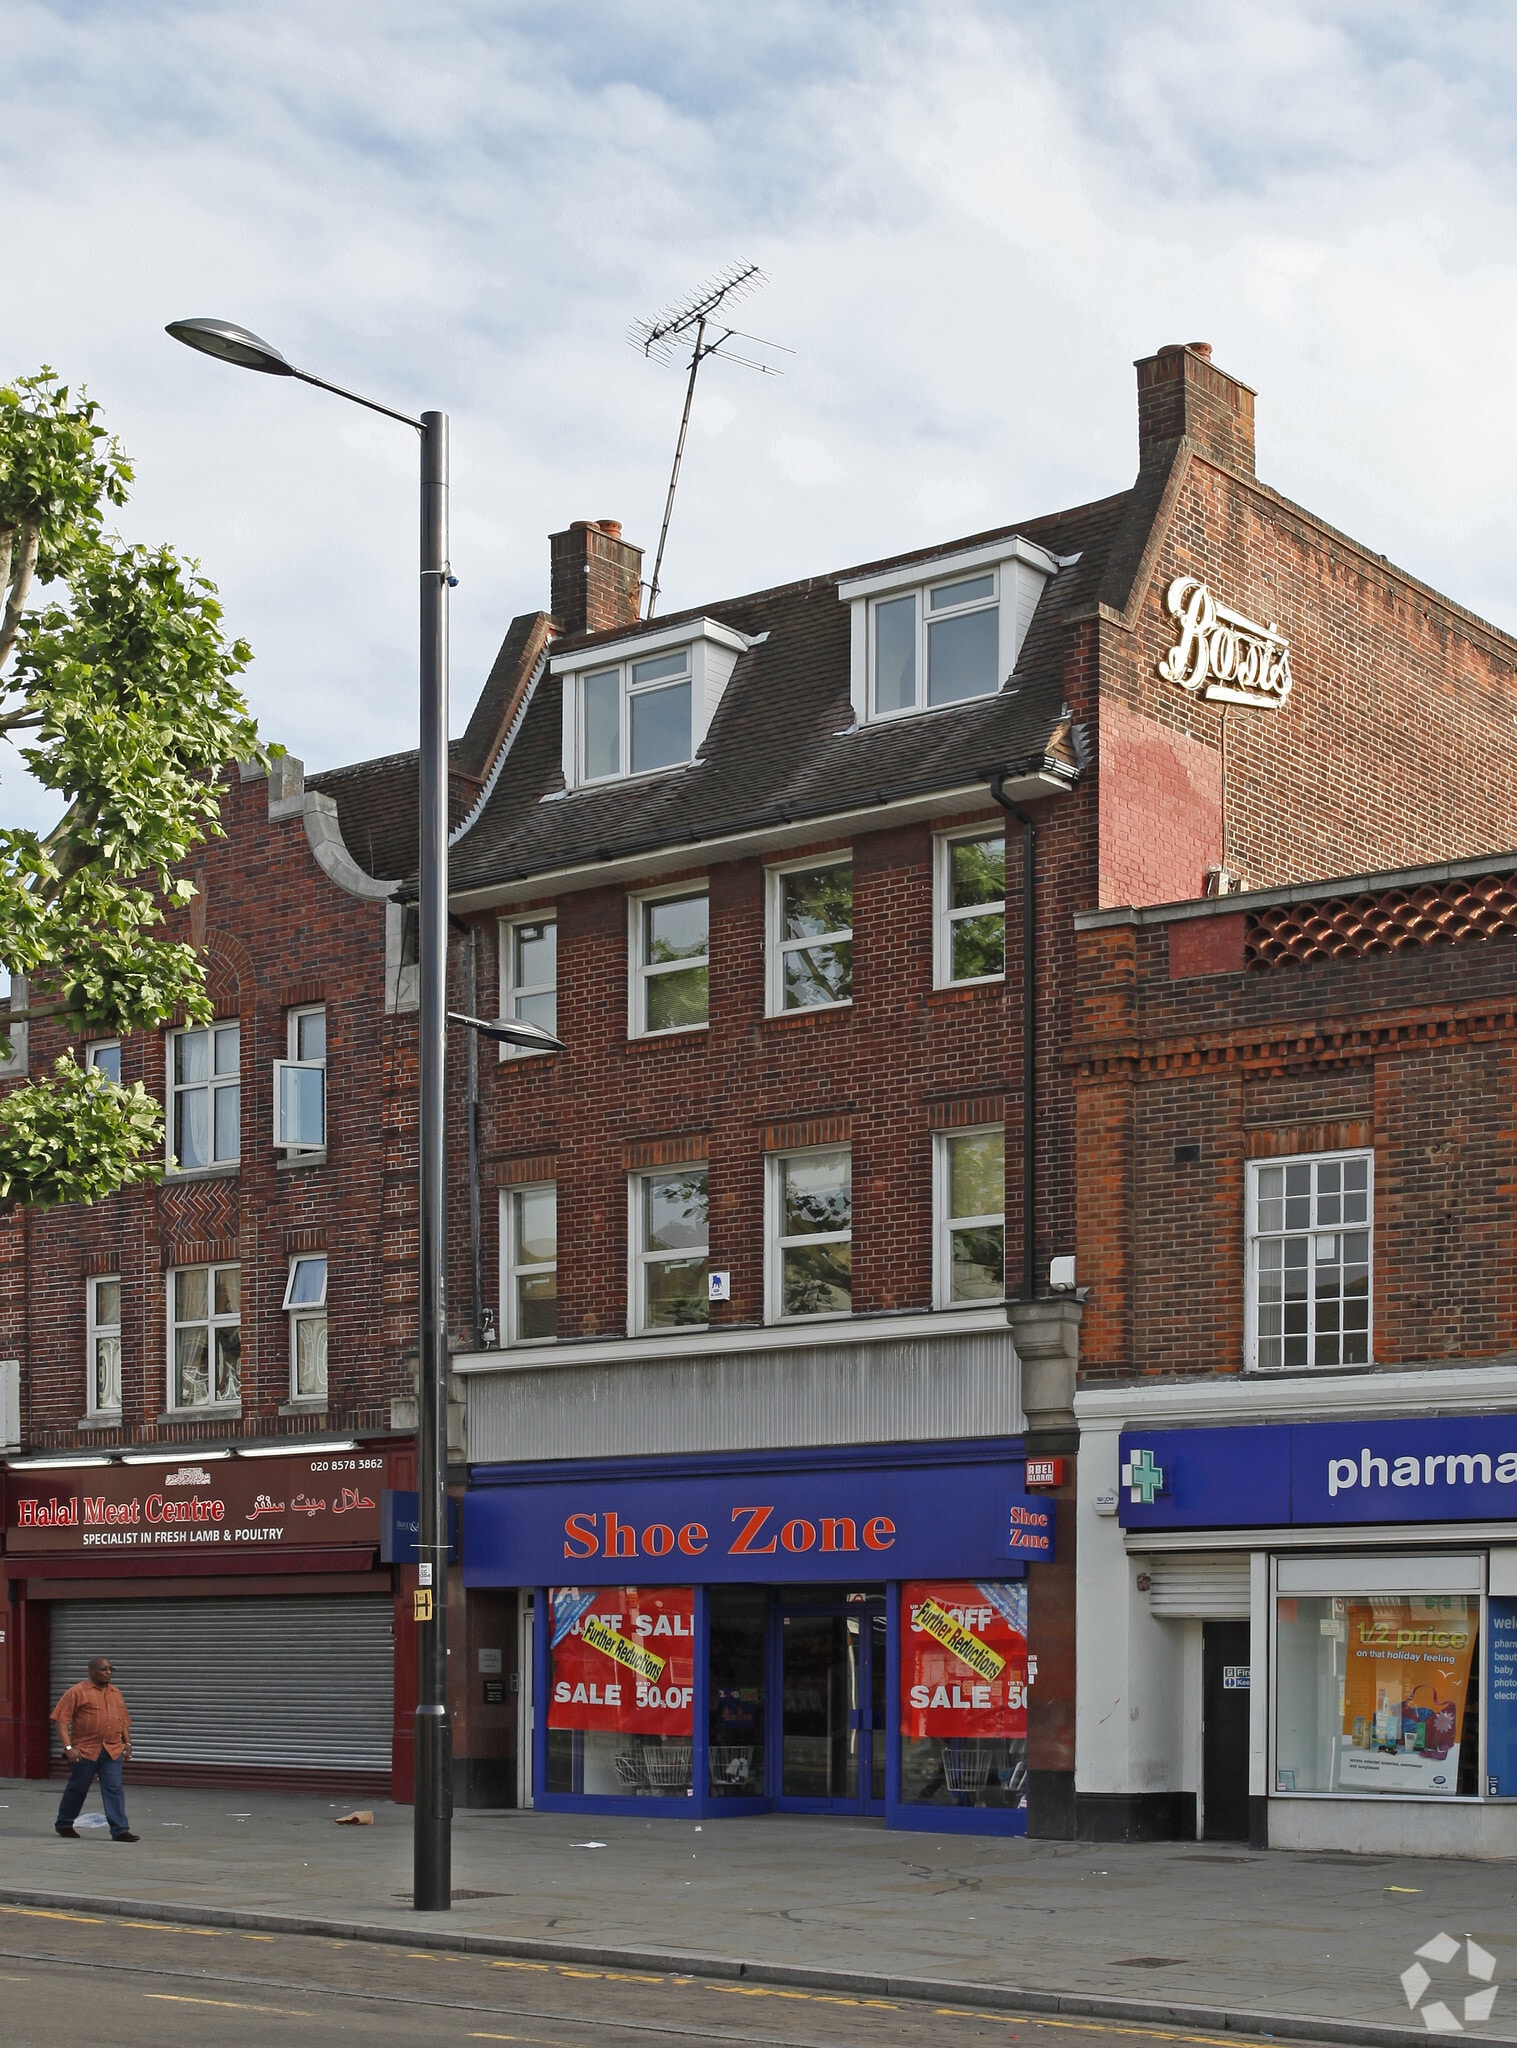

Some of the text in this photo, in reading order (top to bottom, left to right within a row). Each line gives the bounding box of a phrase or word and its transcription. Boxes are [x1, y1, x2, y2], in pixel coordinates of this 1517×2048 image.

[1158, 576, 1293, 709] Boots
[310, 1458, 383, 1472] 020 8578 3862
[1028, 1464, 1053, 1475] ABEL
[1328, 1448, 1517, 1497] pharma
[1028, 1474, 1053, 1482] ALARM
[18, 1494, 225, 1527] Halal Meat Centre
[290, 1493, 326, 1517] ميت
[332, 1487, 376, 1514] حلال
[1010, 1506, 1048, 1527] Shoe
[83, 1528, 284, 1545] SPECIALIST IN FRESH LAMB & POULTRY
[564, 1506, 896, 1559] Shoe Zone
[1009, 1528, 1049, 1550] Zone
[635, 1614, 694, 1636] SAL
[1493, 1615, 1517, 1630] wel
[916, 1602, 953, 1640] Further
[947, 1627, 1000, 1679] Reductions
[1356, 1621, 1391, 1644] 1/2
[1396, 1625, 1467, 1649] price
[584, 1621, 663, 1681] Further Reductions
[1370, 1649, 1385, 1658] that
[1387, 1651, 1420, 1662] holiday
[1423, 1653, 1455, 1665] feeling
[1494, 1665, 1514, 1675] baby
[554, 1681, 622, 1706] SALE
[909, 1685, 992, 1709] SALE
